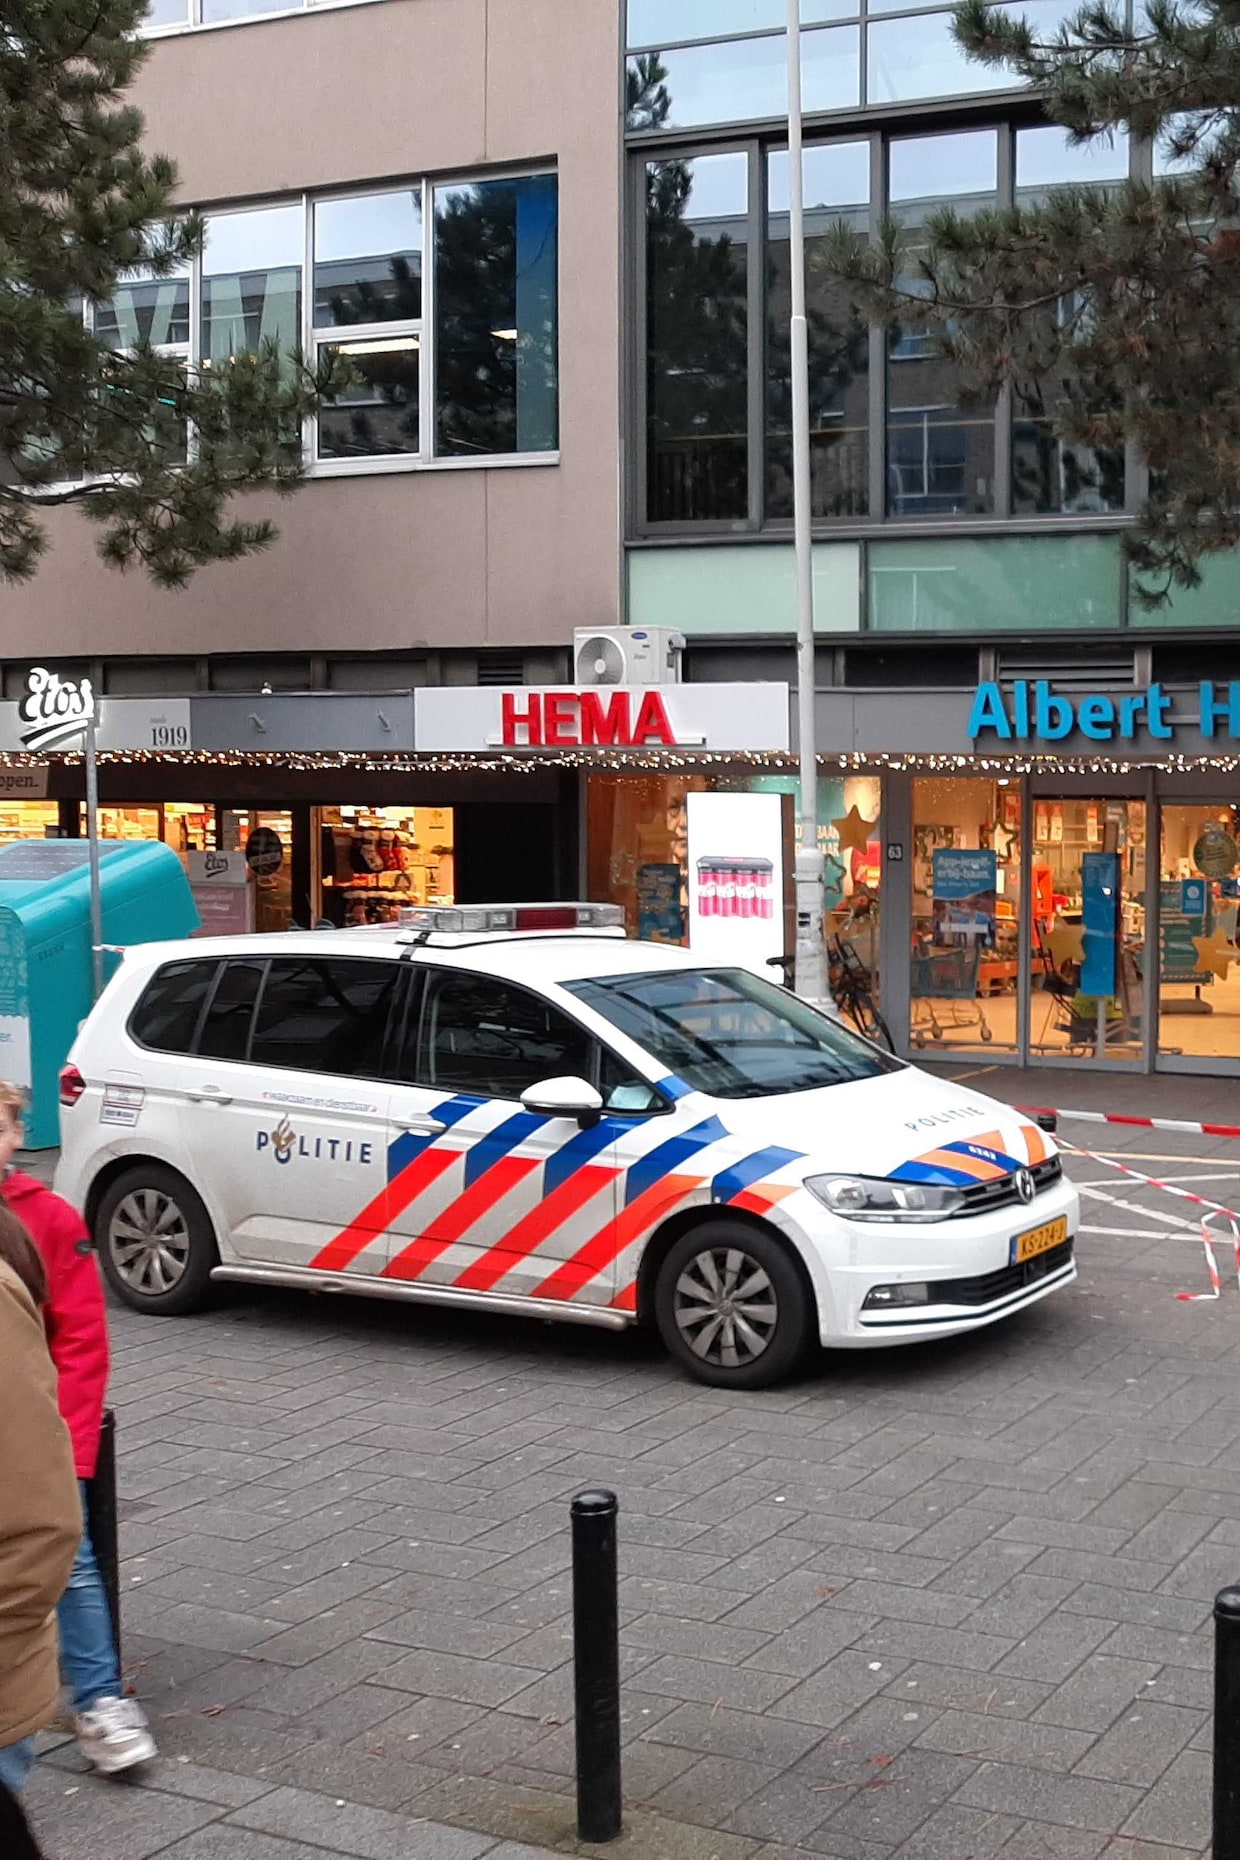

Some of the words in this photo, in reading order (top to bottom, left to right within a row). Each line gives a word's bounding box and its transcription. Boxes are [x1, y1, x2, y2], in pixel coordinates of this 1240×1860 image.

[19, 667, 94, 723] Etos
[966, 679, 1173, 740] Albert
[502, 691, 677, 746] HEMA
[151, 726, 187, 747] 1919
[205, 853, 228, 871] Etos
[887, 846, 902, 860] 63
[904, 1106, 985, 1132] POLITIE
[257, 1130, 372, 1164] POLITIE
